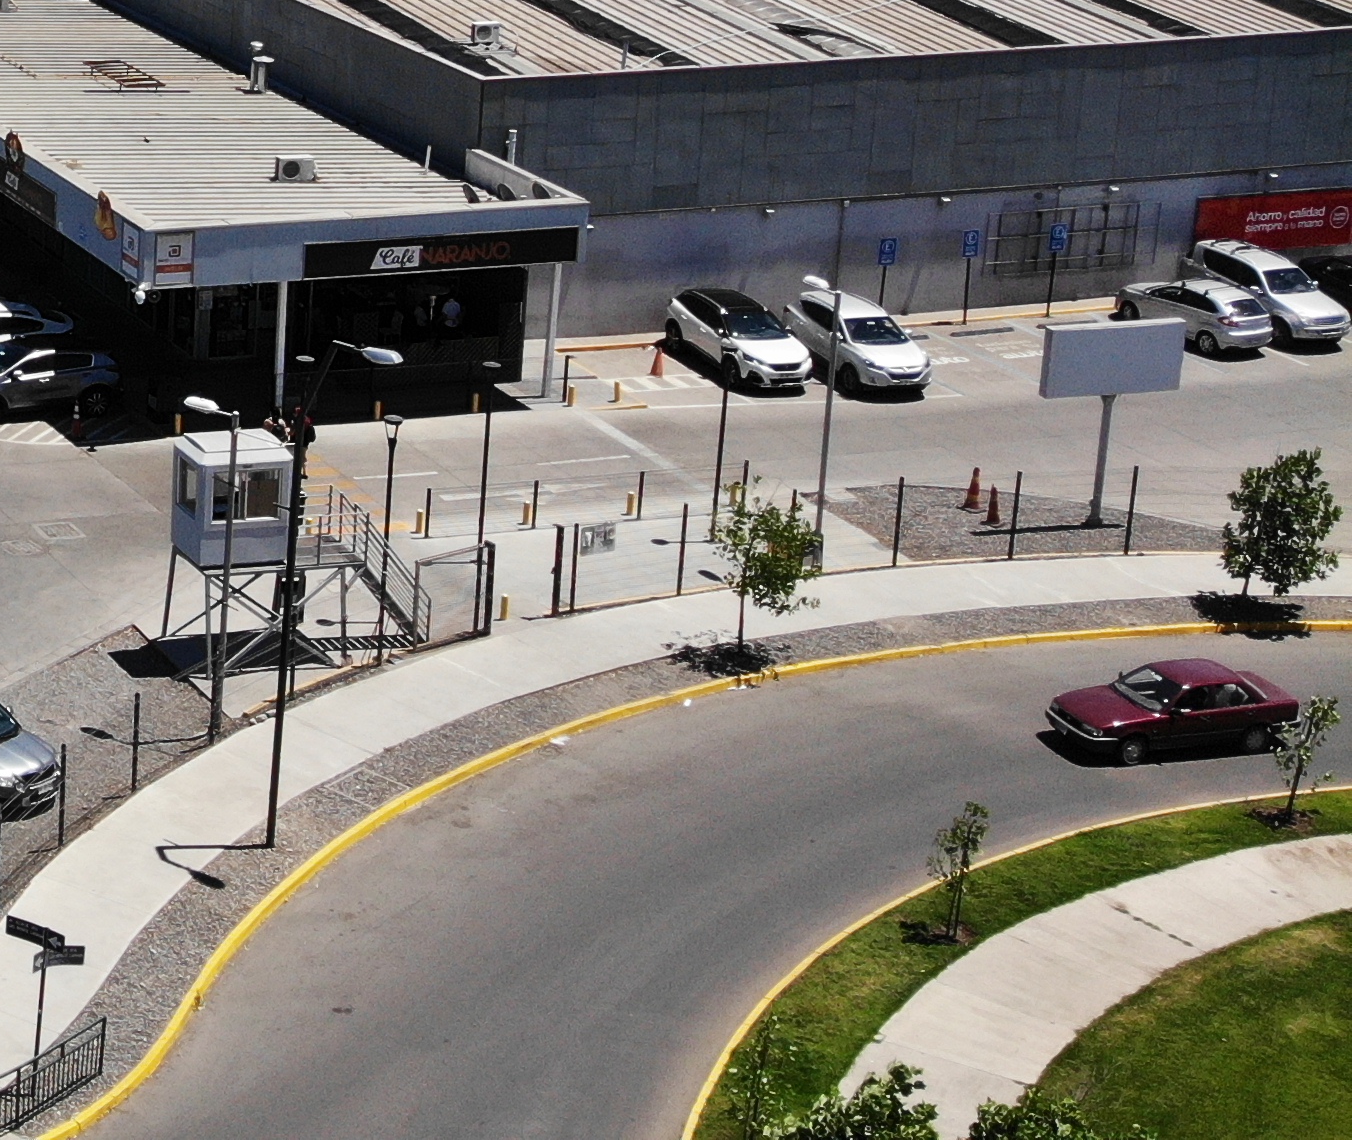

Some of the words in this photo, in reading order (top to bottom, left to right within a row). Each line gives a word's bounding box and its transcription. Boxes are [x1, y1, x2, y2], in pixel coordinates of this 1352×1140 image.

[1246, 210, 1282, 222] Ahorro
[1289, 206, 1325, 219] calidad
[379, 250, 415, 268] Café
